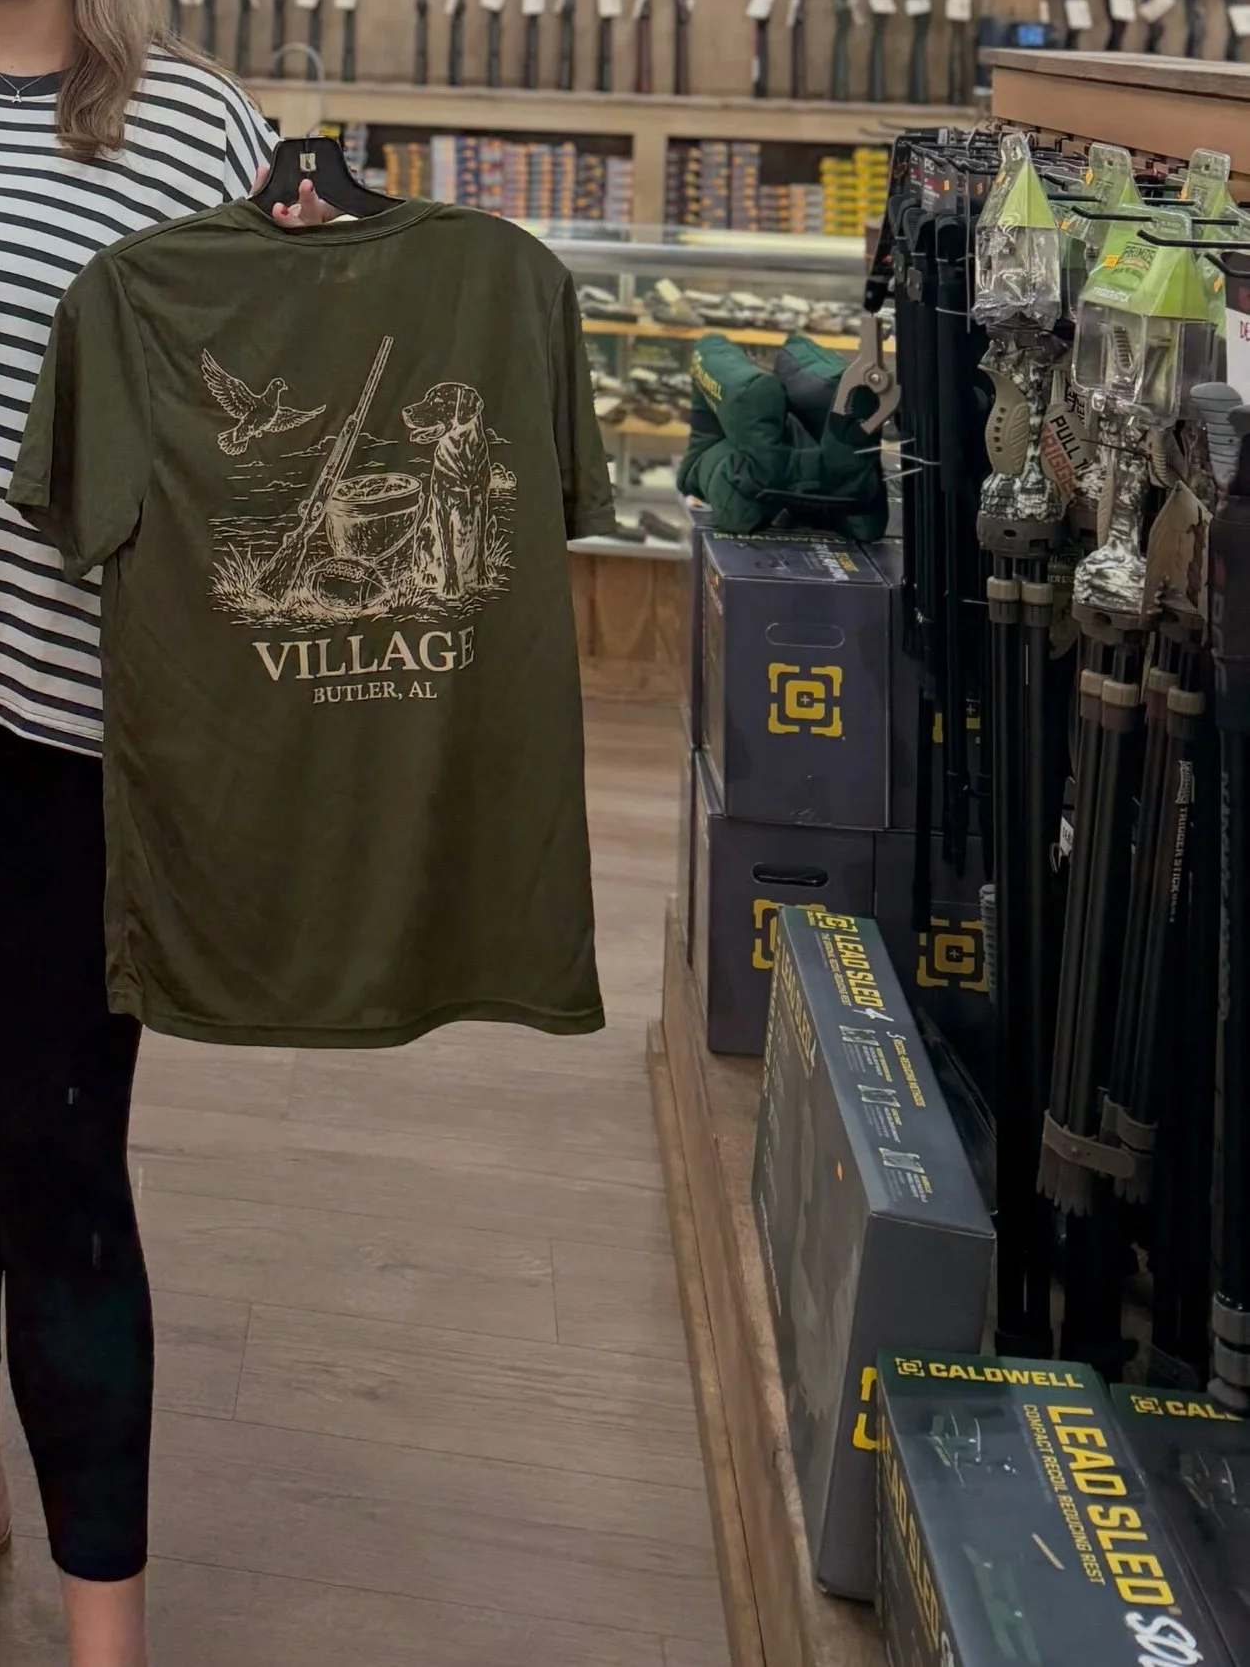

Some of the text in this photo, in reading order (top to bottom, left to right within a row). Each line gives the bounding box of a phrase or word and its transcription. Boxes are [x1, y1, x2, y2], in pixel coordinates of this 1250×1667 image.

[1050, 415, 1081, 460] PULL
[252, 625, 476, 682] VILLAGE
[313, 680, 438, 705] BUTLER, AL
[834, 934, 870, 970] LEAD
[846, 970, 884, 1008] SLED
[928, 1362, 1085, 1389] CALDWELL
[1165, 1399, 1245, 1422] CAL
[1022, 1404, 1106, 1586] COMPACT RECOIL REDUCING REST
[1046, 1404, 1128, 1497] LEAD
[1087, 1504, 1176, 1606] SLED
